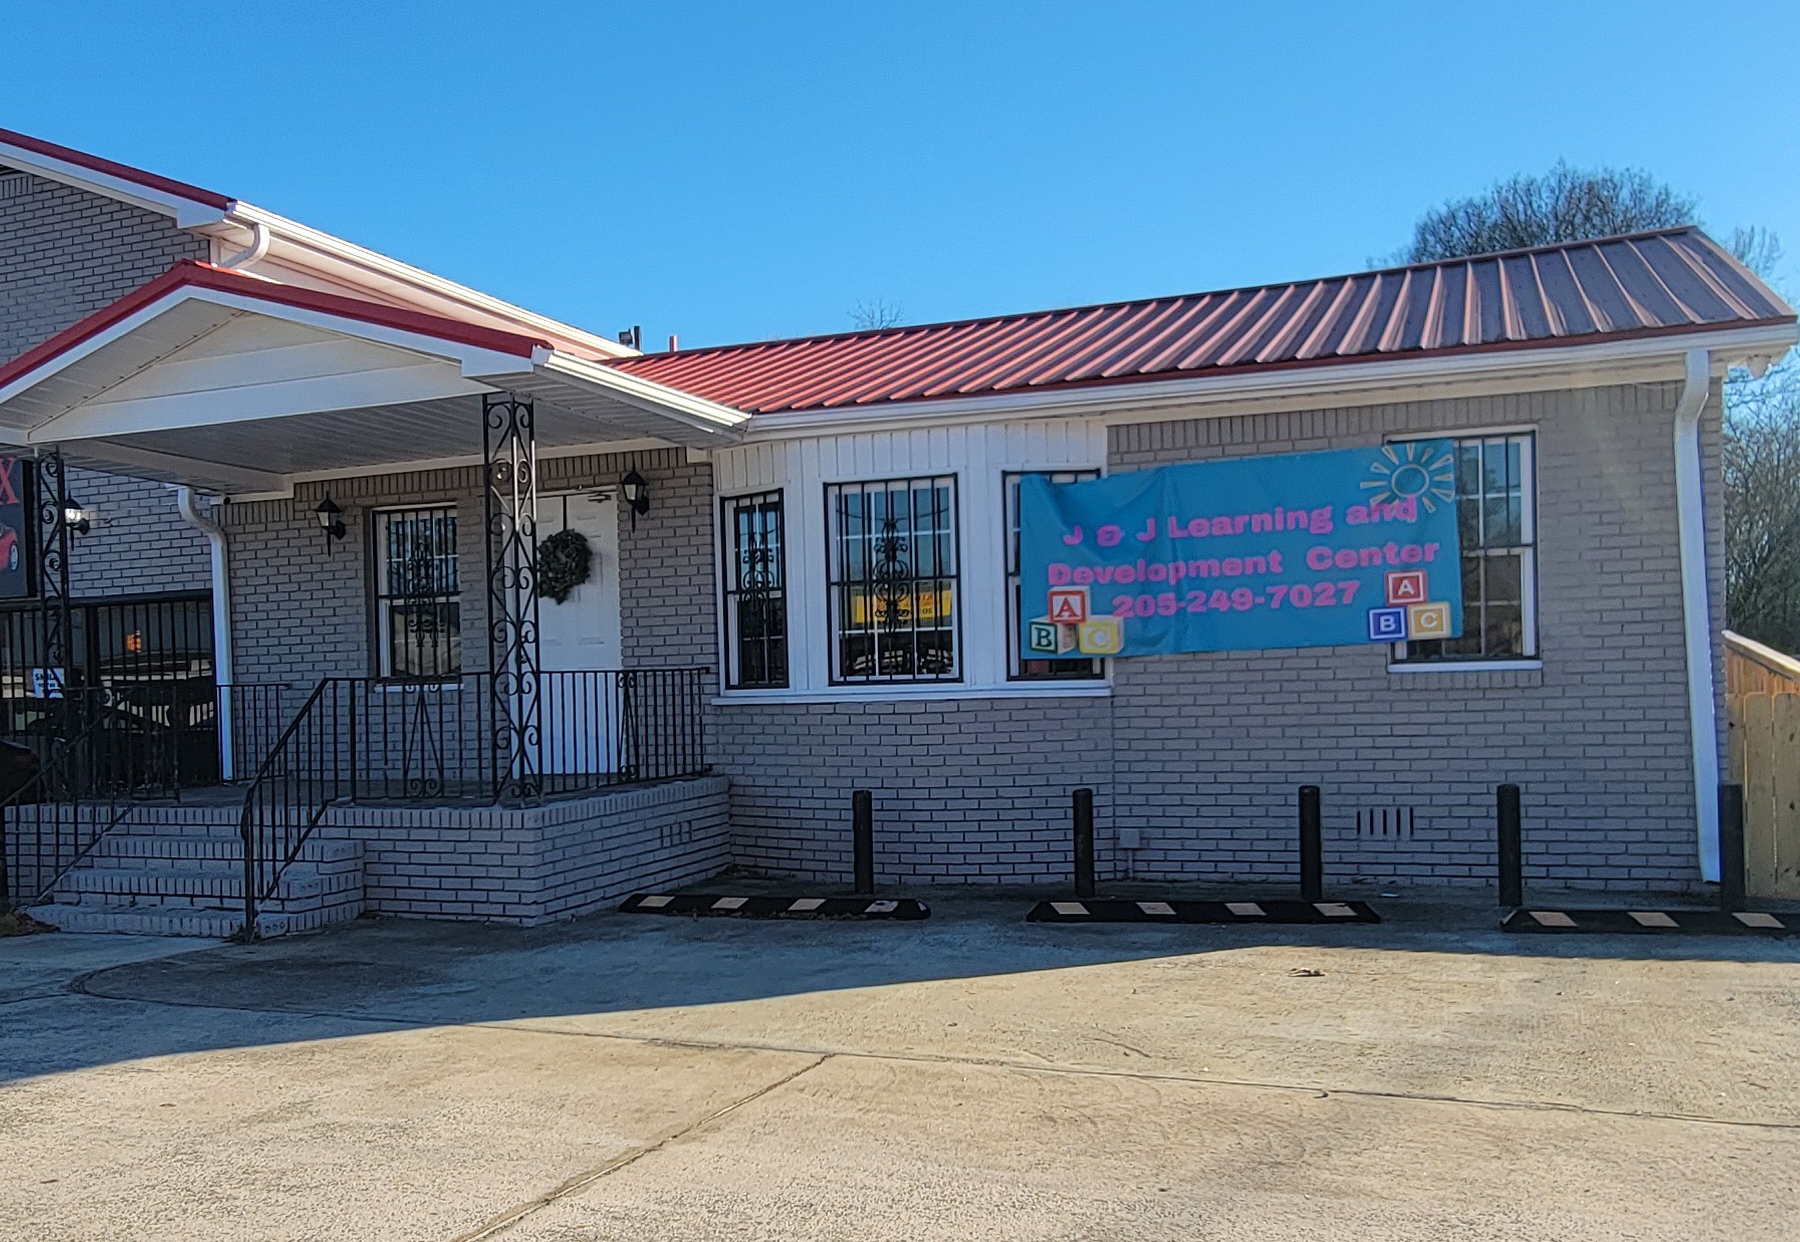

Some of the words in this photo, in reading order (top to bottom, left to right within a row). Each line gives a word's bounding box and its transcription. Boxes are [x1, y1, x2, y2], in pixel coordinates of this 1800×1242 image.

[1062, 525, 1084, 546] J
[1095, 524, 1125, 547] &
[1136, 517, 1157, 542] J
[1168, 505, 1334, 538] Learning
[1345, 494, 1418, 524] and
[1048, 550, 1283, 586] Development
[1306, 541, 1440, 571] Center
[1111, 580, 1361, 619] 205-249-7027
[1397, 579, 1416, 597] A
[1054, 597, 1080, 618] A
[1378, 614, 1397, 632] B
[1419, 611, 1439, 629] C
[1034, 626, 1054, 648] B
[1087, 625, 1109, 649] C
